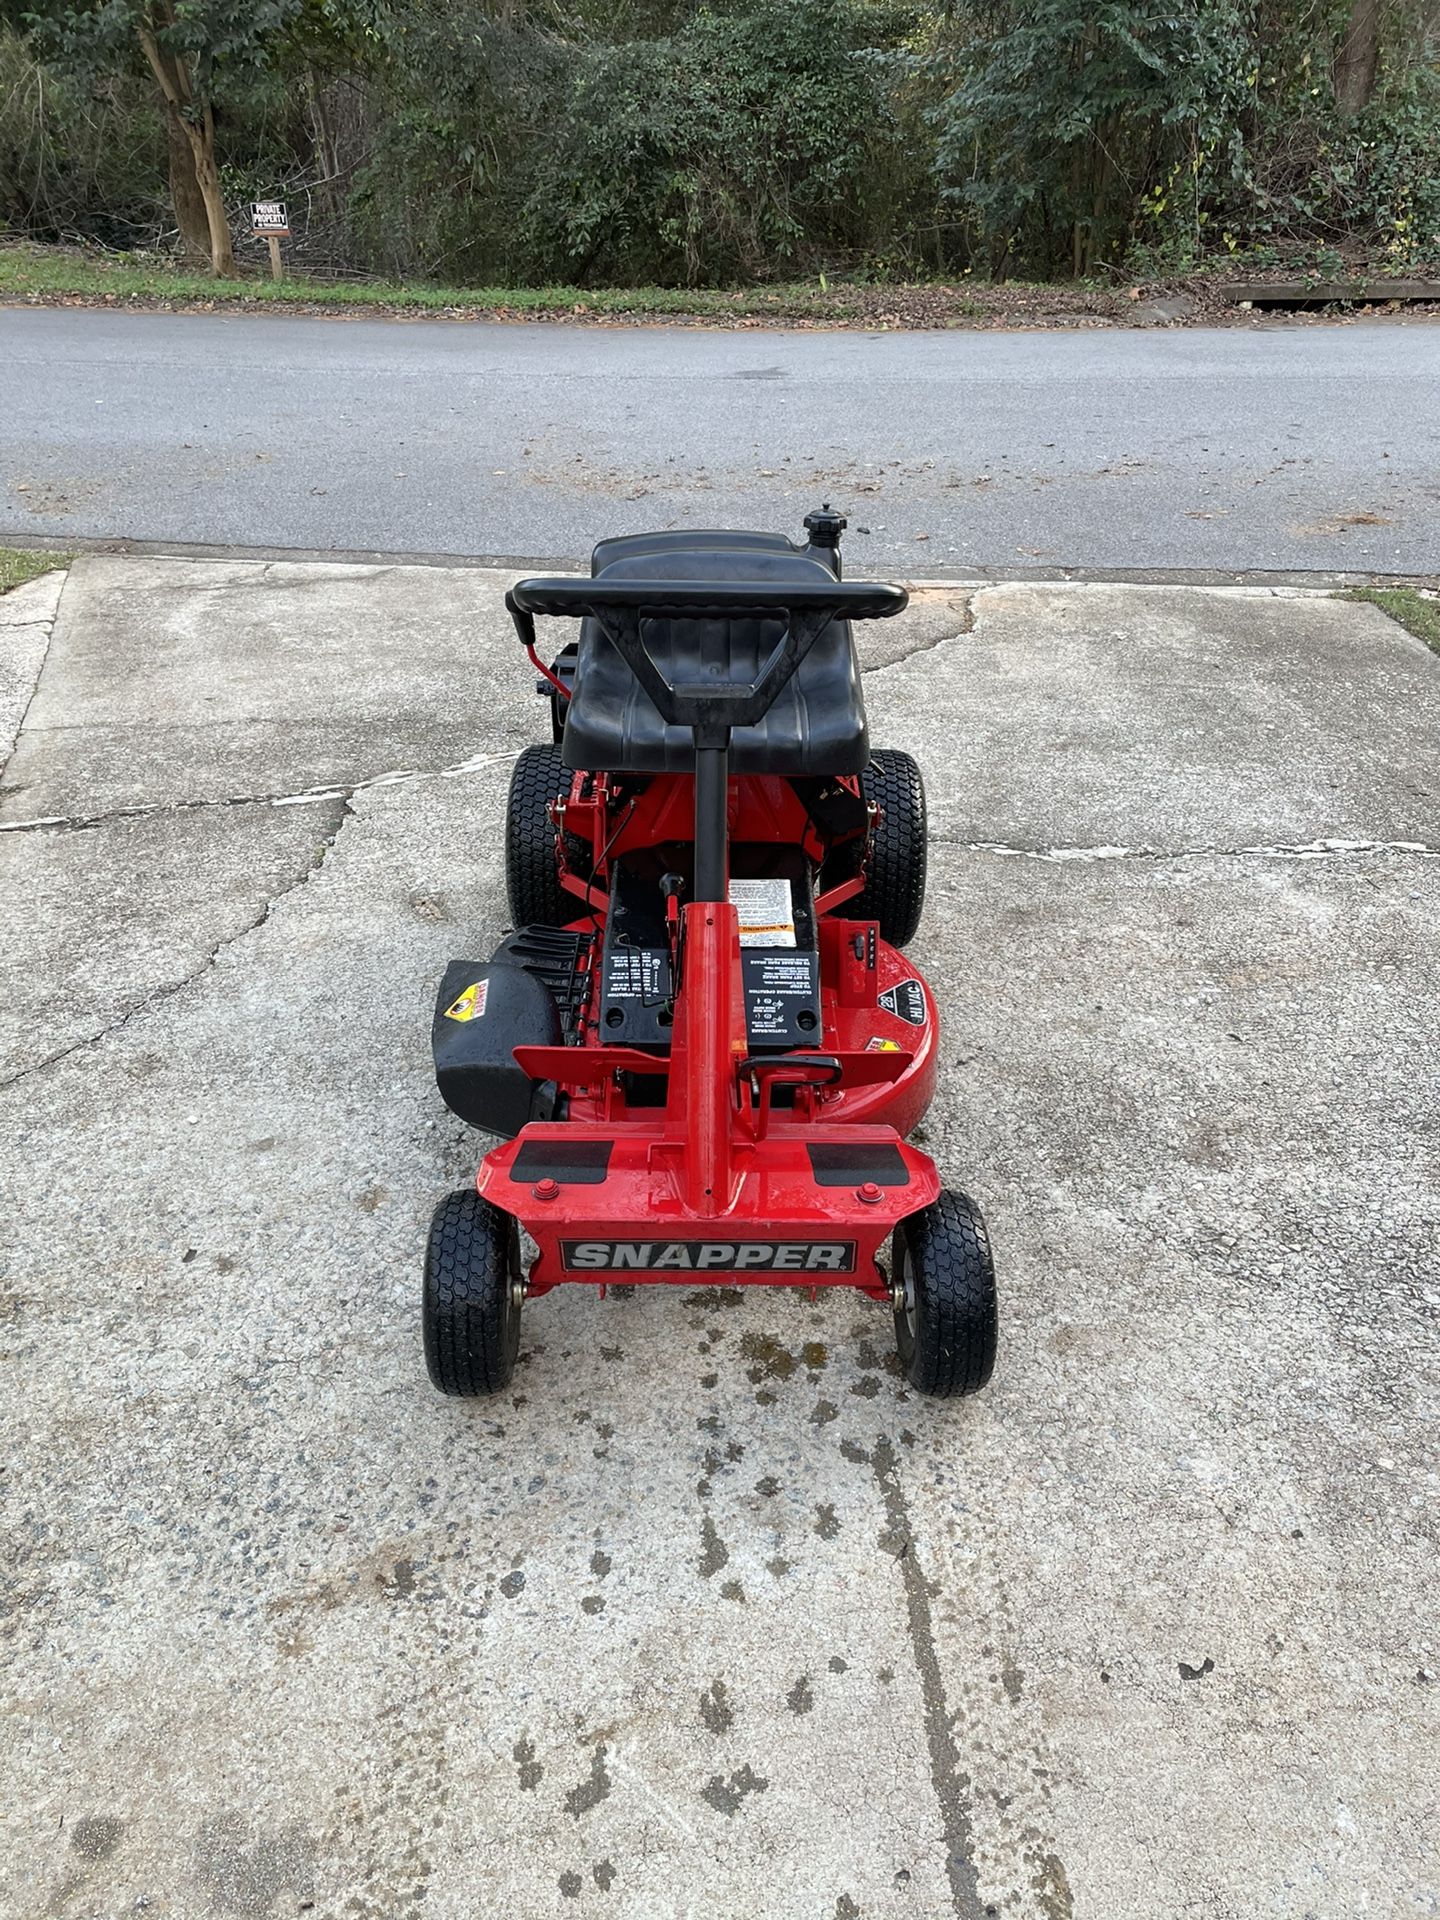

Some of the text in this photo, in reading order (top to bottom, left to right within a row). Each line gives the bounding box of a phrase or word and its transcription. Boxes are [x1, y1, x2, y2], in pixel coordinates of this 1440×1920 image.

[253, 214, 285, 223] PROPERTY
[255, 204, 281, 214] PRIVATE
[476, 983, 487, 1014] DANGER
[880, 996, 894, 1009] 28
[907, 986, 923, 1019] HI VAC
[571, 1243, 846, 1270] SNAPPER
